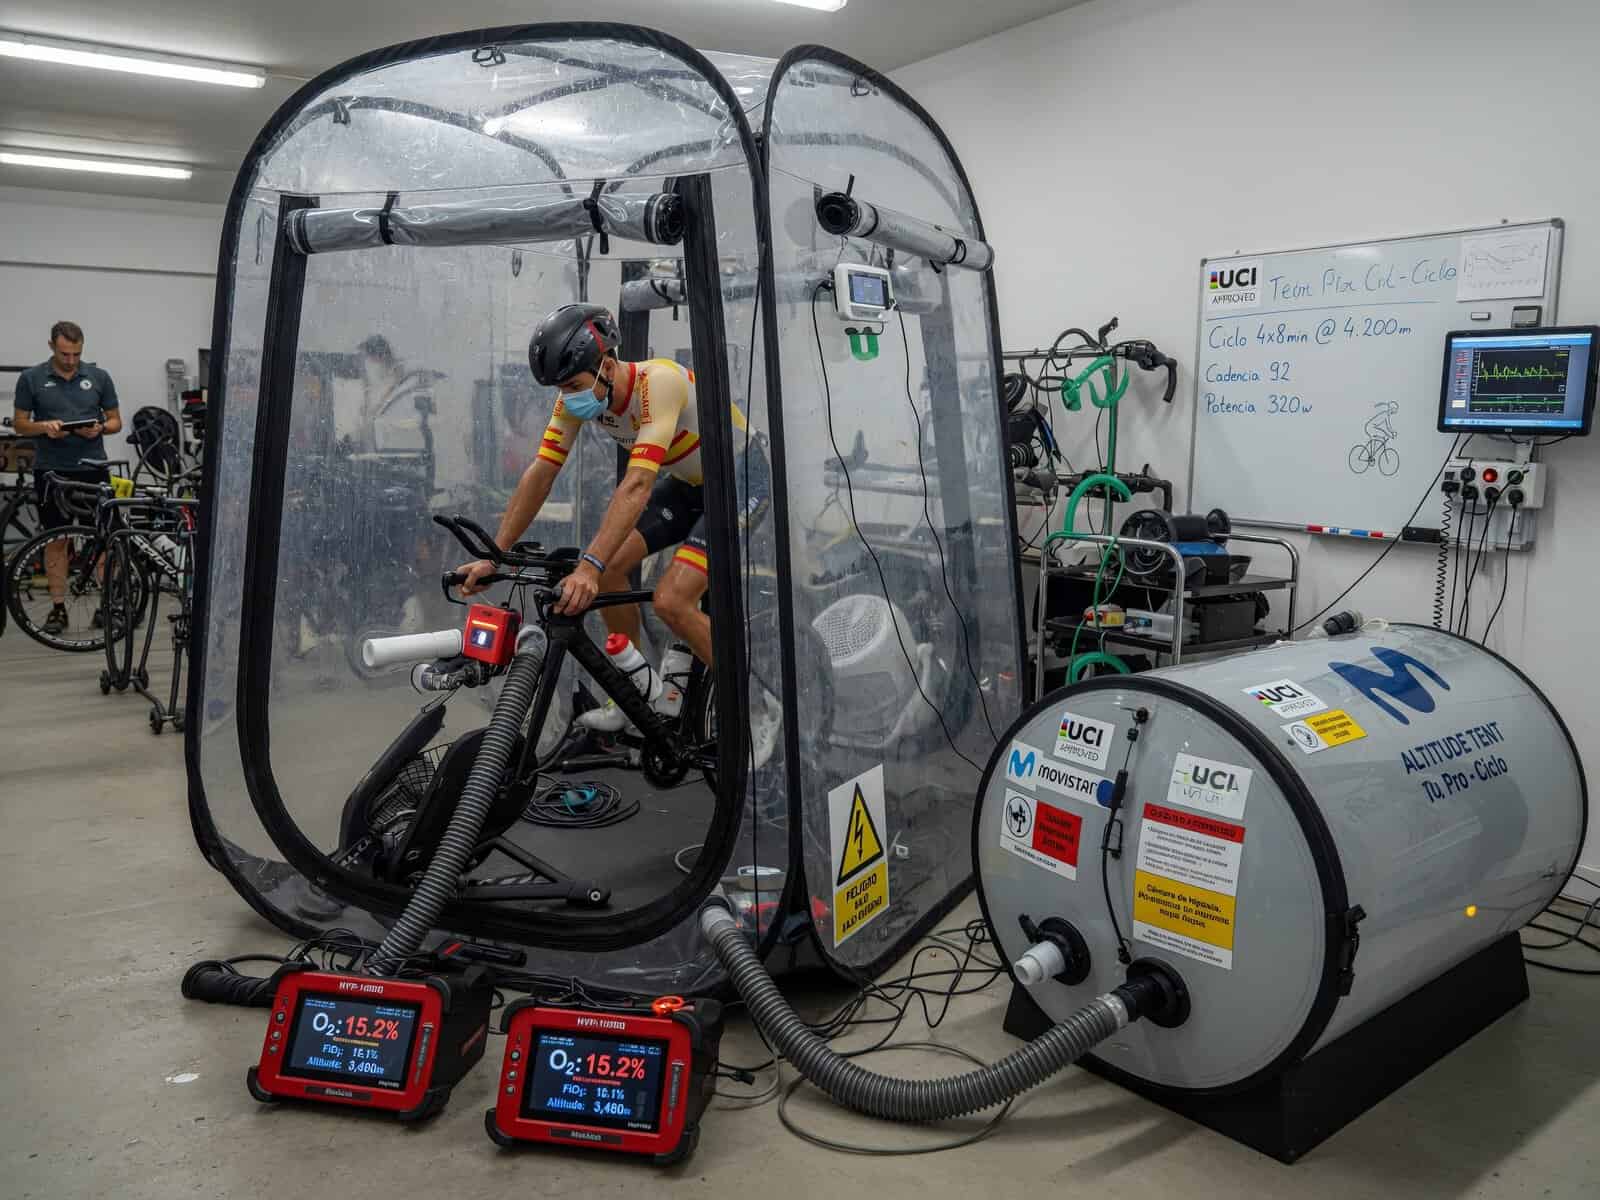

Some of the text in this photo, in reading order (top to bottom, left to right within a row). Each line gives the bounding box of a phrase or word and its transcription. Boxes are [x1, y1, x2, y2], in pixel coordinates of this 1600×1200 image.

[1219, 267, 1257, 289] UCI
[1208, 325, 1248, 349] Ciclo
[1315, 318, 1336, 345] @
[1205, 361, 1290, 383] Cadencia 92
[1205, 392, 1256, 415] Potencia
[1258, 684, 1303, 703] UCI
[1068, 721, 1104, 747] UCI
[1401, 721, 1504, 775] ALTITUDE TENT
[346, 1016, 400, 1041] 15.2%
[586, 1054, 645, 1080] 15.2%
